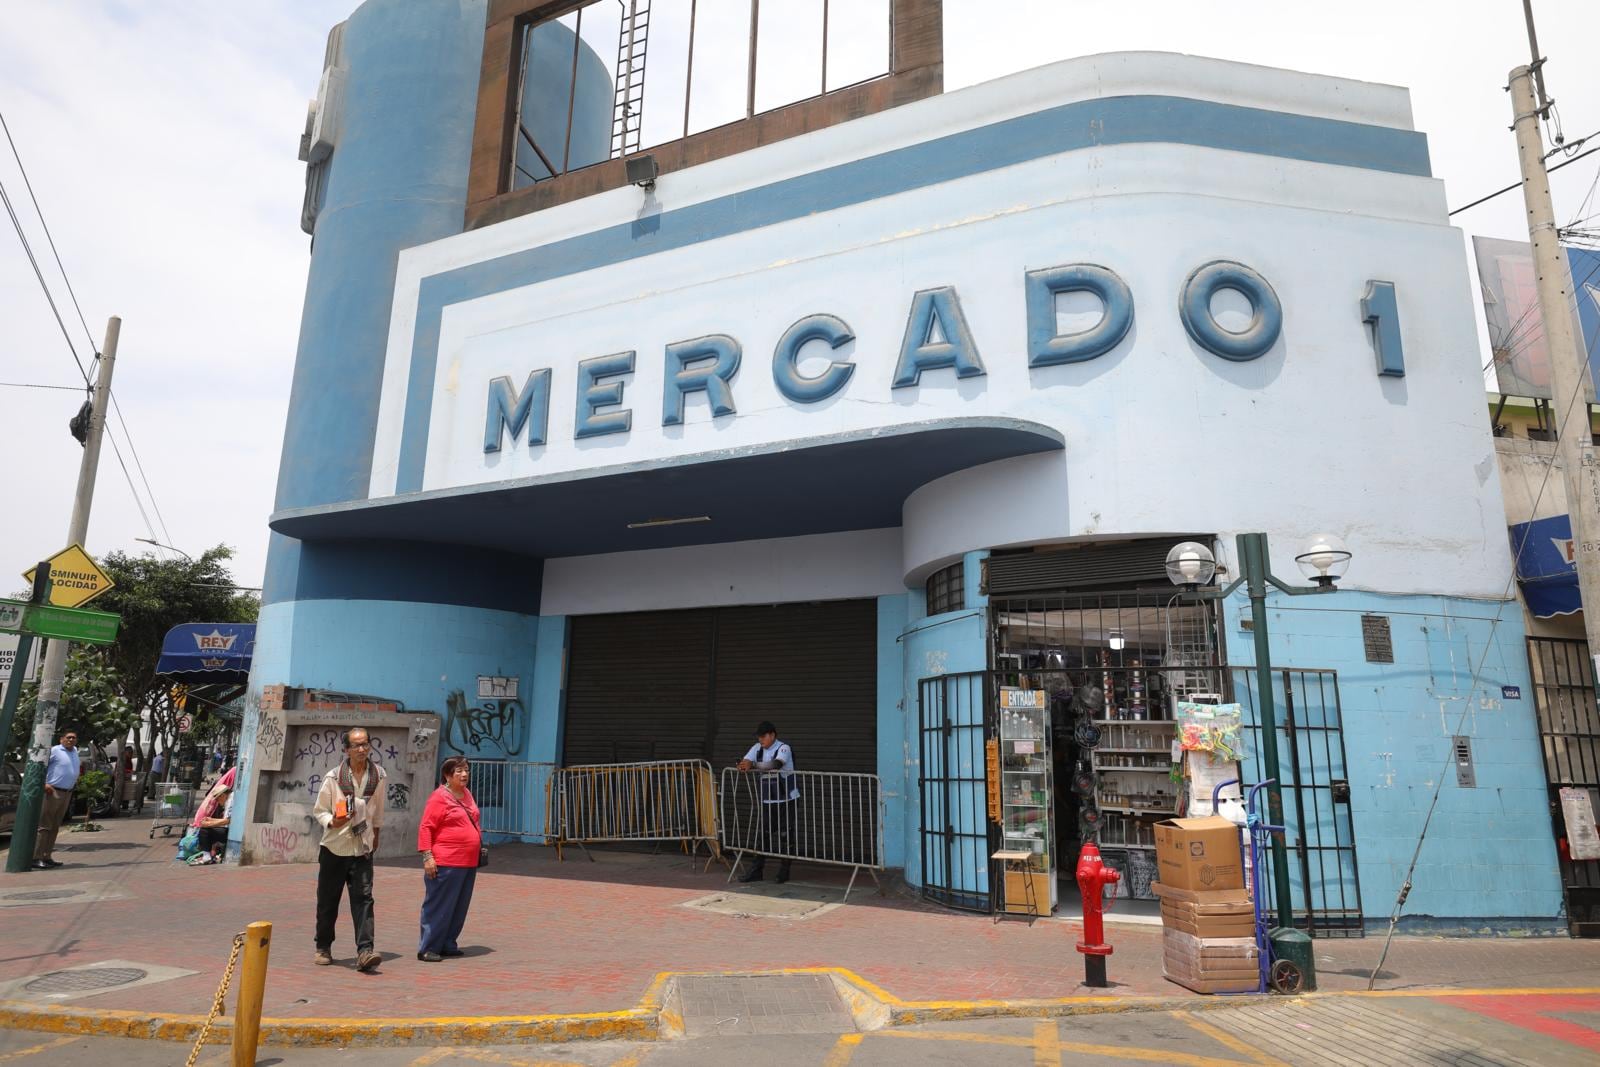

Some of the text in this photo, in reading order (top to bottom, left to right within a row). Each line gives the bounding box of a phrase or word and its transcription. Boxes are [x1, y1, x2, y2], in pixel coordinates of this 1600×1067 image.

[483, 258, 1406, 455] MERCADO 1
[50, 569, 98, 582] SMINUIR
[51, 579, 98, 591] LOCIDAD
[200, 637, 232, 649] REY
[205, 659, 225, 667] REY
[1008, 690, 1037, 707] ENTRADA
[1504, 690, 1519, 698] VISA
[262, 826, 298, 853] CHAPO
